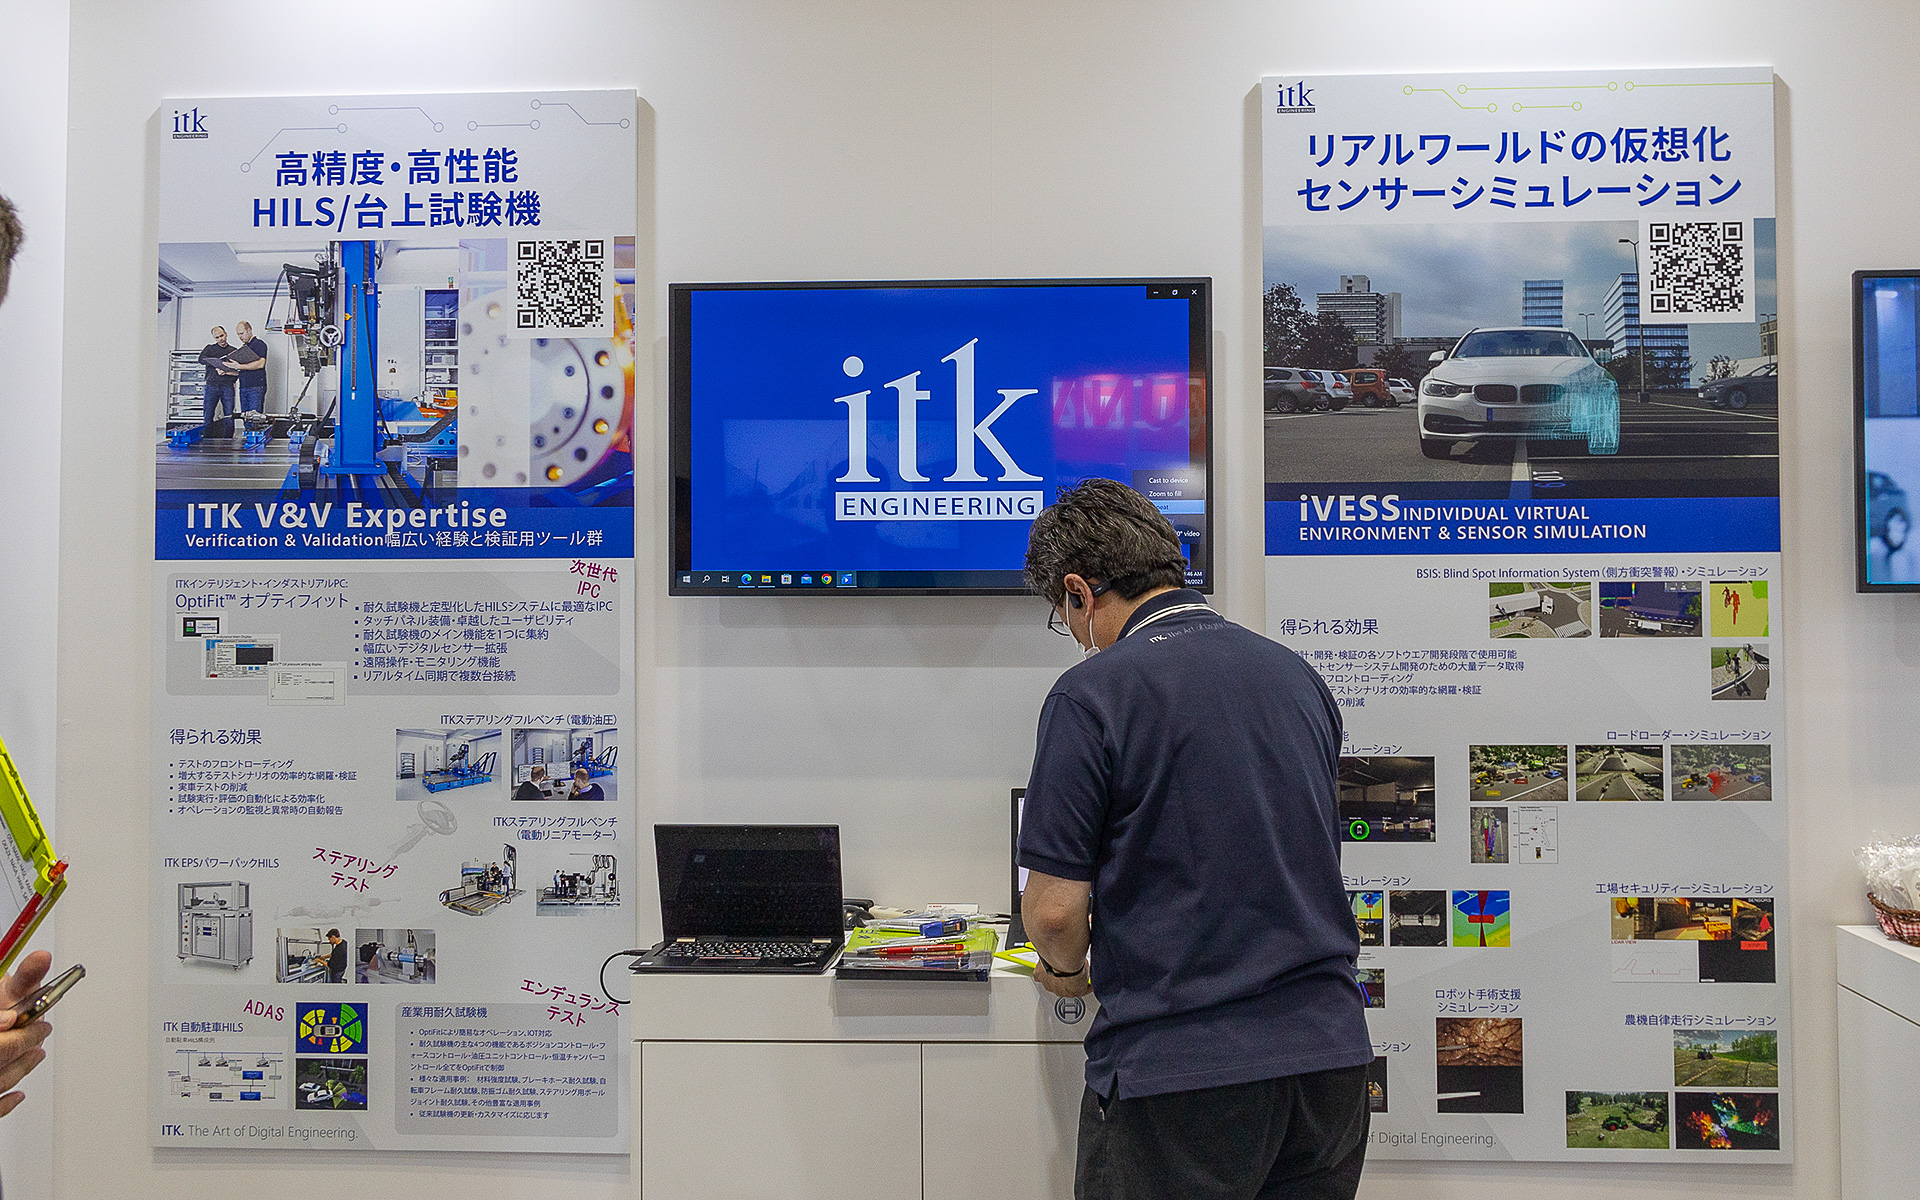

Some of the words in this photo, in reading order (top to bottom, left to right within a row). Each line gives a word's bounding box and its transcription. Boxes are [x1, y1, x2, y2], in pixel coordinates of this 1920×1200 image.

[1277, 80, 1315, 107] itk
[173, 106, 208, 132] itk
[1310, 126, 1731, 167] リアルワールドの仮想化
[276, 148, 518, 186] 高精度・高性能
[1297, 174, 1741, 211] センサーシミュレーション
[254, 191, 540, 232] HILS/台上試験機
[832, 336, 1045, 484] itk
[1148, 476, 1162, 484] Cast
[1162, 476, 1170, 484] to
[1170, 476, 1189, 484] device
[1148, 490, 1166, 498] Zoom
[1167, 490, 1174, 498] to
[842, 496, 1036, 518] ENGINEERING
[1300, 494, 1400, 521] iVESS
[1404, 507, 1508, 520] INDIVIDUAL
[1515, 507, 1589, 519] VIRTUAL
[188, 503, 242, 528] ITK
[255, 503, 332, 528] V&V
[343, 501, 511, 543] Expertise
[186, 534, 277, 546] Verification
[285, 534, 295, 546] &
[1300, 527, 1431, 540] ENVIRONMENT
[1439, 527, 1450, 539] &
[1458, 526, 1527, 539] SENSOR
[1534, 525, 1645, 538] SIMULATION
[567, 557, 621, 586] 次世代
[1416, 568, 1441, 579] BSIS:
[1444, 569, 1469, 578] Blind
[1472, 568, 1497, 582] Spot
[1499, 568, 1559, 577] Information
[578, 581, 600, 598] IPC
[240, 592, 348, 608] オプティフィット
[364, 614, 573, 626] タッチパネル装備・卓越したユーザビリティ
[1281, 619, 1378, 635] 得られる効果
[364, 643, 507, 654] 幅広いデジタルセンサー拡張
[363, 656, 500, 668] 遠隔操作・モニタリング機能
[364, 670, 516, 682] リアルタイム同期で複数台接続
[170, 729, 261, 744] 得られる効果
[1607, 730, 1771, 740] ロードローダー・シミュレーション
[179, 760, 294, 768] テストのフロントローディング
[179, 783, 247, 792] 実車テストの削減
[494, 817, 617, 827] ITKステアリングフルベンチ
[165, 858, 179, 867] ITK
[182, 858, 279, 868] EPSパワーパックHILS
[311, 847, 399, 879] ステアリング
[331, 871, 370, 892] テスト
[1596, 883, 1773, 894] 工場セキュリティーシミュレーション
[520, 979, 621, 1016] エンデュランス
[1436, 989, 1521, 1000] ロボット手術支援
[244, 1000, 284, 1021] ADAS
[402, 1006, 487, 1018] 産業用耐久試験機
[1438, 1003, 1518, 1013] シミュレーション
[546, 1005, 586, 1027] テスト
[1625, 1014, 1776, 1026] 農機自律走行シミュレーション
[164, 1021, 178, 1031] ITK
[182, 1022, 243, 1033] 自動駐車HILS
[162, 1125, 184, 1136] ITK.
[188, 1124, 209, 1136] The
[213, 1126, 230, 1136] Art
[234, 1125, 245, 1137] of
[249, 1126, 284, 1140] Digital
[289, 1126, 358, 1141] Engineering.
[1378, 1131, 1416, 1147] Digital
[1422, 1132, 1496, 1147] Engineering.
